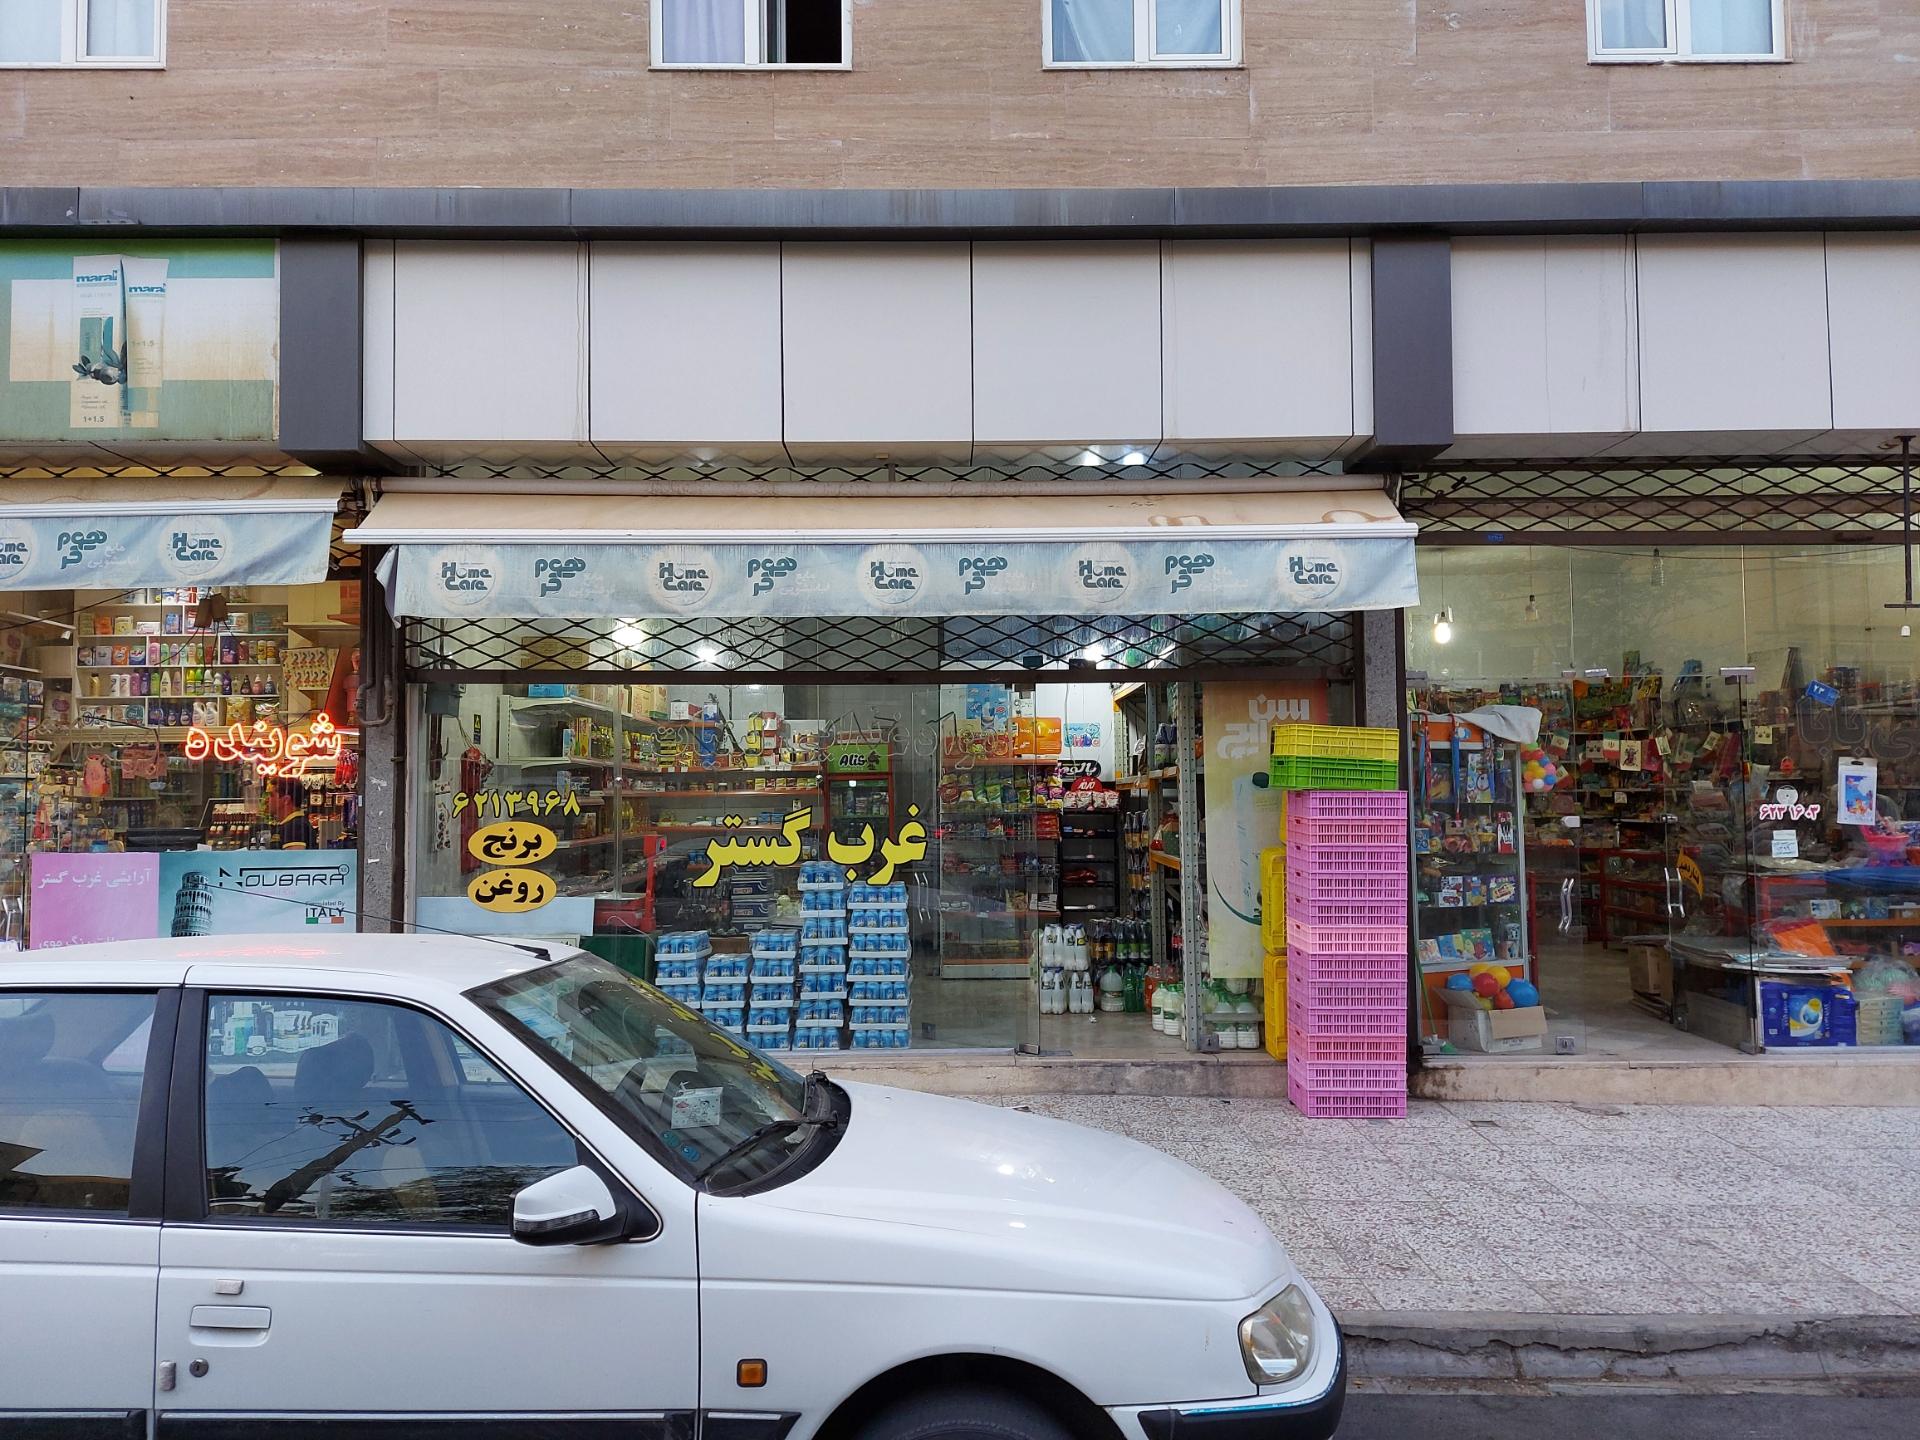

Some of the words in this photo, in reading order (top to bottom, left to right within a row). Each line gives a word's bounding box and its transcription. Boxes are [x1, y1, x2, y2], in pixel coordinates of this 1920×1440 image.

[173, 532, 222, 549] Home
[176, 547, 218, 561] Care
[441, 562, 492, 578] Home
[659, 562, 709, 579] Home
[870, 561, 919, 577] Home
[1079, 560, 1127, 576] Home
[1289, 556, 1338, 573] Home
[445, 577, 488, 591] Care
[663, 577, 706, 591] Care
[874, 576, 916, 589] Care
[1083, 575, 1123, 588] Care
[1294, 570, 1336, 585] Care
[839, 753, 867, 768] Alis
[452, 790, 581, 818] ۶۲۱۳۹۶۸
[482, 828, 542, 858] برنج
[692, 806, 813, 887] گستر
[827, 803, 928, 886] غرب
[37, 870, 69, 889] گستر
[73, 871, 102, 888] غرب
[106, 868, 153, 888] آرایشی
[220, 867, 344, 888] NOUBARA
[475, 873, 544, 903] روغن
[306, 908, 344, 917] ITALY
